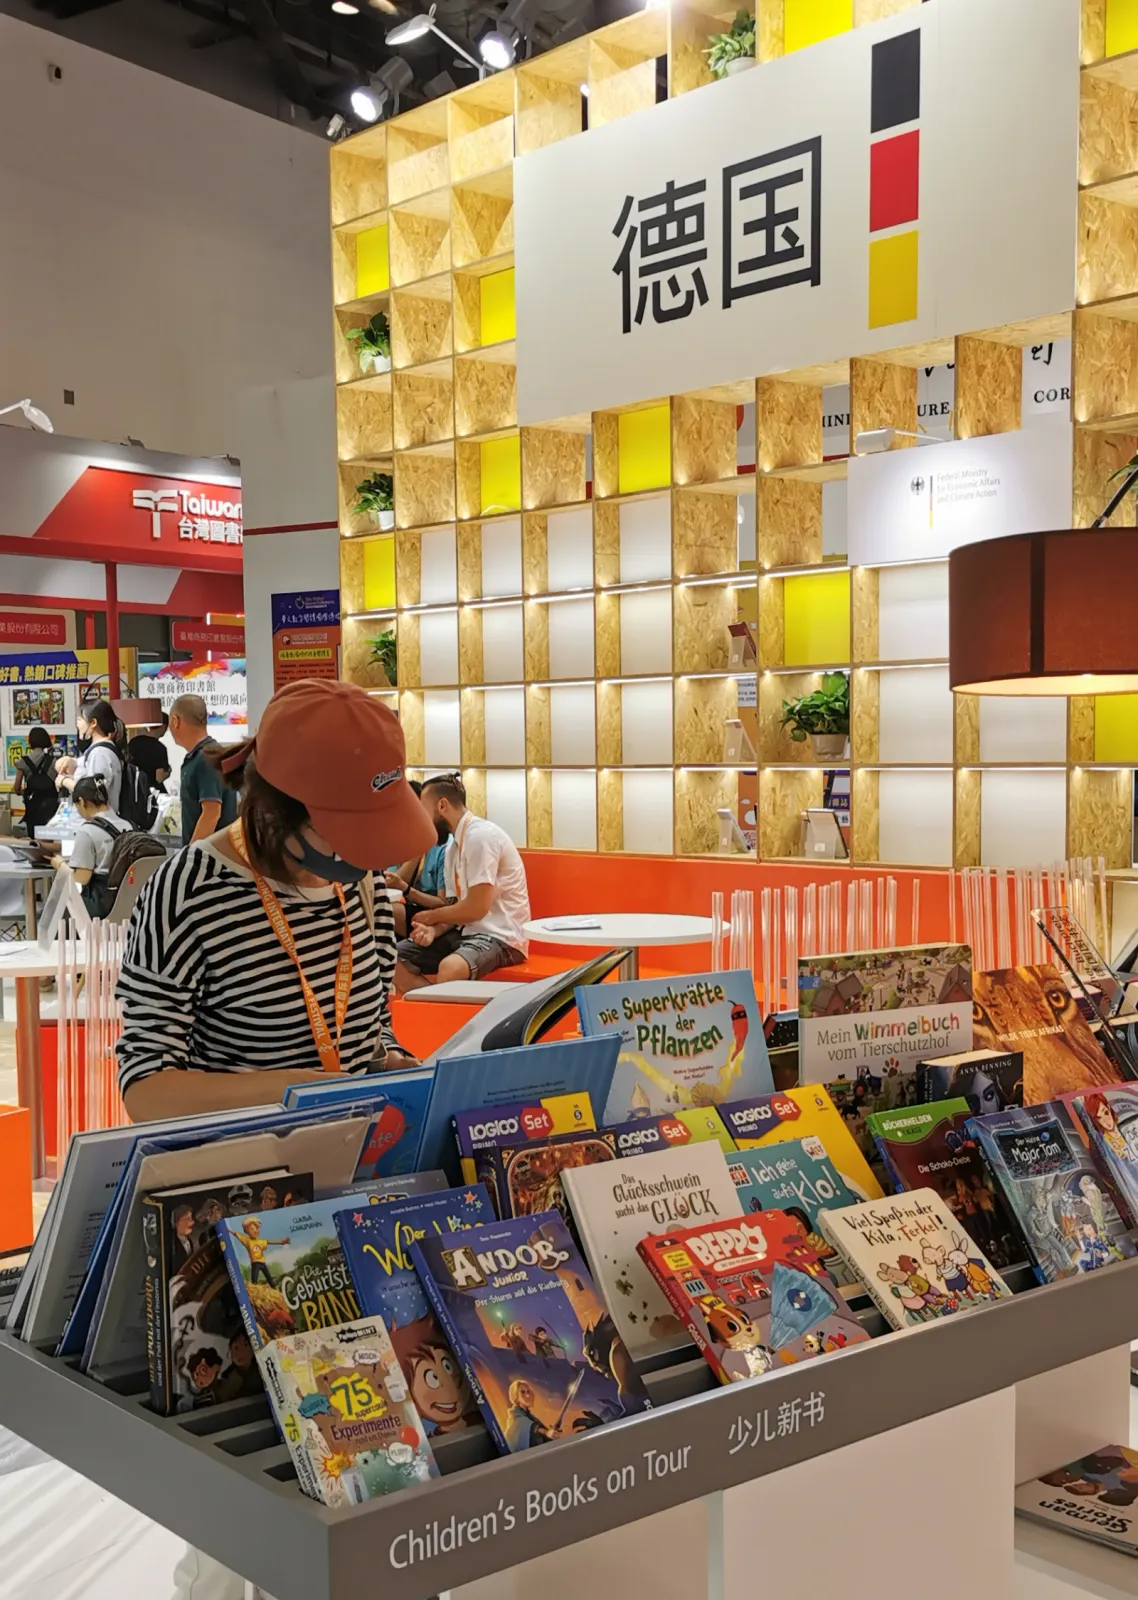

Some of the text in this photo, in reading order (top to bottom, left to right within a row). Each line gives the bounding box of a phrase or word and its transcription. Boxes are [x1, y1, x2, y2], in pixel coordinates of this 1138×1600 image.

[612, 135, 822, 334] 德国
[962, 469, 987, 479] Ministry
[975, 489, 997, 498] Action
[178, 516, 243, 544] 台灣圖書
[598, 981, 724, 1025] Die Superkräfte
[307, 998, 326, 1039] FESTIVAL
[676, 1014, 696, 1031] der
[817, 1012, 960, 1046] Mein Wimmelbuch
[636, 1024, 724, 1058] Pflanzen
[828, 1031, 952, 1061] vom Tierschutzhof
[524, 1112, 550, 1131] Set
[774, 1100, 796, 1116] Set
[662, 1121, 688, 1139] Set
[882, 1114, 932, 1131] BÜCHERHELDEN
[1011, 1147, 1040, 1165] Major
[1039, 1142, 1061, 1157] Tom
[621, 1173, 636, 1184] Das
[734, 1179, 750, 1187] WAS
[751, 1158, 799, 1185] Ich gehe
[918, 1164, 930, 1174] Die
[612, 1173, 701, 1203] Glücksschwein
[772, 1165, 841, 1212] aufs Klo!
[615, 1188, 720, 1225] sucht das GLÜCK
[843, 1200, 933, 1231] Viel Spaß in der
[402, 1225, 426, 1245] Der
[897, 1215, 948, 1241] Ferkel!
[685, 1222, 768, 1266] BEPPO
[303, 1264, 322, 1279] Die
[451, 1237, 569, 1287] ANDOR
[492, 1270, 528, 1288] JUNIOR
[475, 1296, 488, 1308] Der
[489, 1292, 512, 1305] Sturm
[514, 1287, 526, 1300] auf
[527, 1284, 538, 1295] die
[330, 1378, 372, 1415] 75
[281, 1413, 303, 1443] 75
[331, 1415, 402, 1440] Experimente
[728, 1391, 826, 1455] 少儿新书
[388, 1445, 692, 1570] Children's Books on Tour
[1038, 1501, 1128, 1534] German
[1053, 1498, 1133, 1528] Stories
